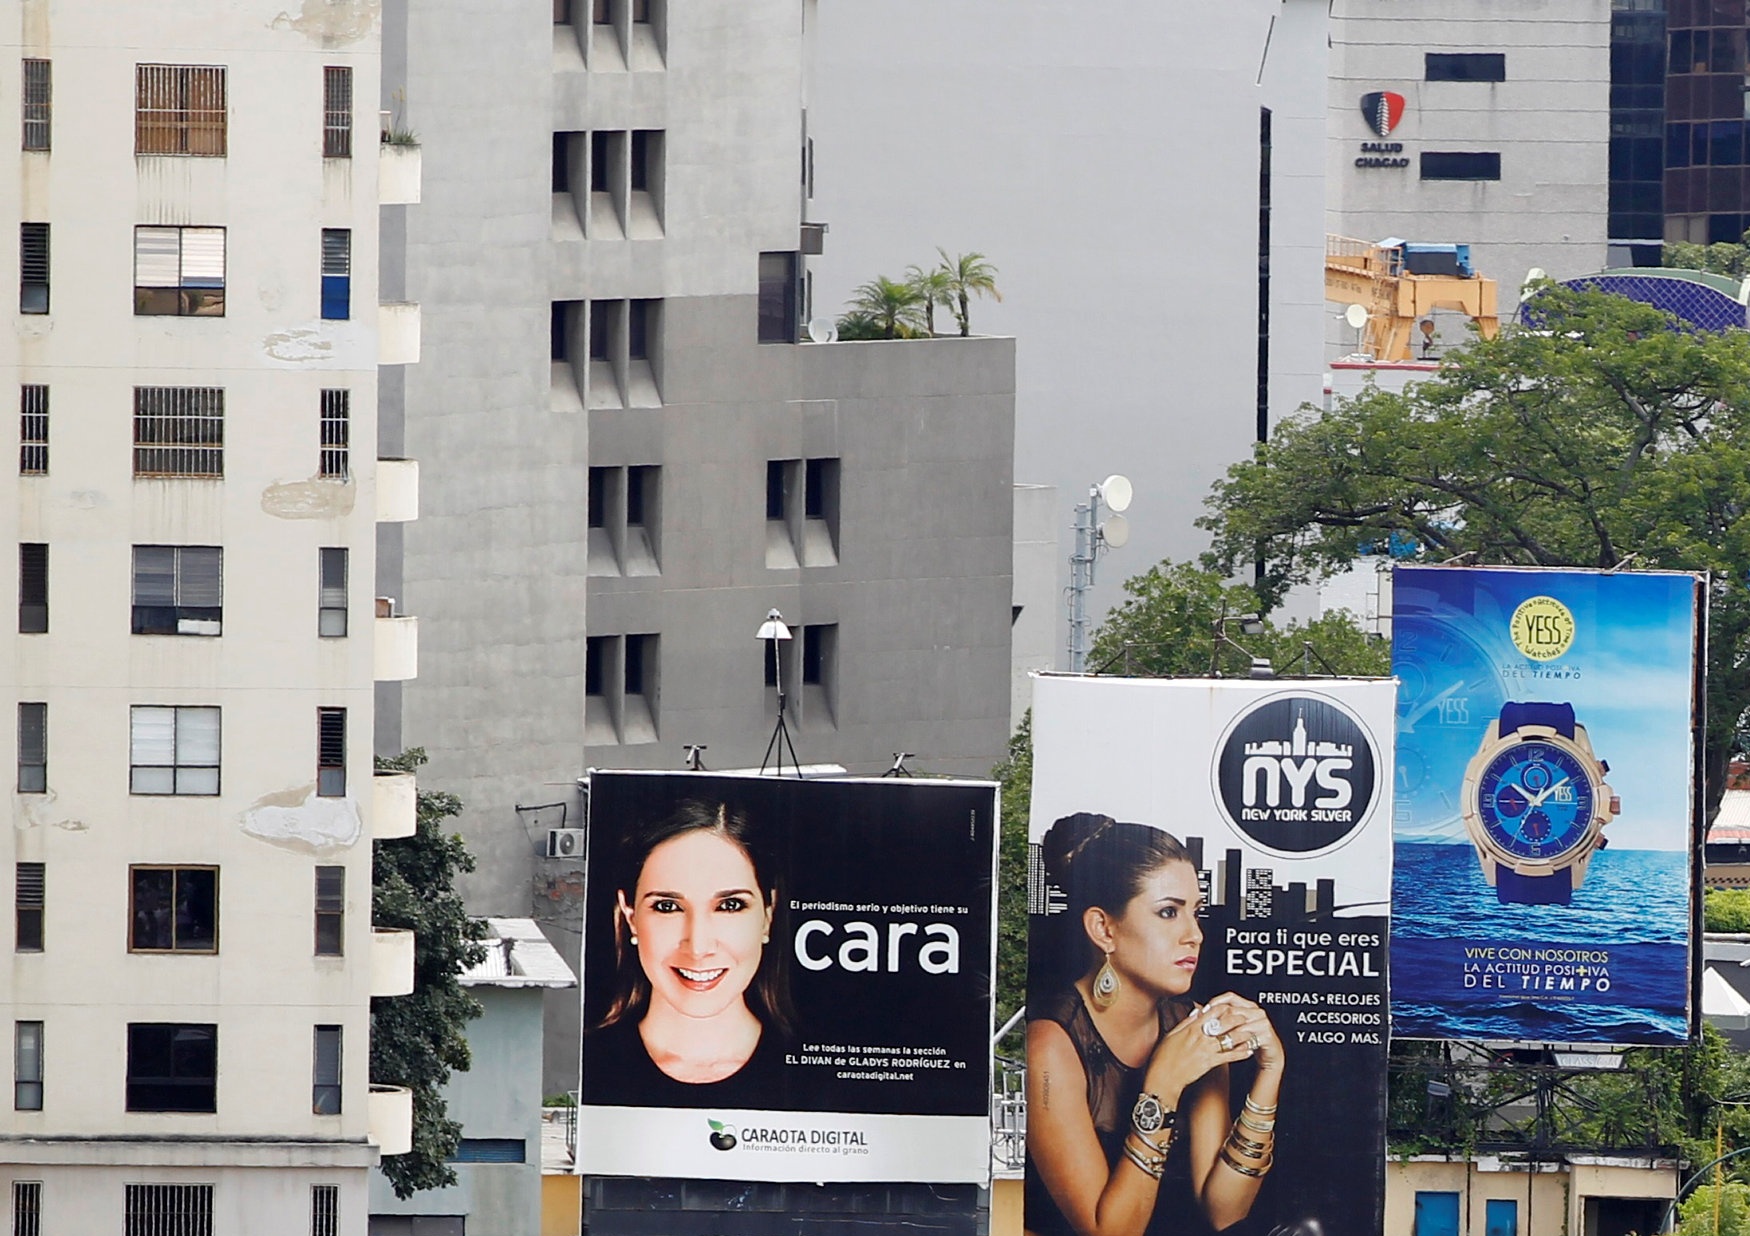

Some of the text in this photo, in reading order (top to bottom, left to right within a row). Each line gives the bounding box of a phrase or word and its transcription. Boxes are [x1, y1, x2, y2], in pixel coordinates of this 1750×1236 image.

[1360, 143, 1403, 153] SALUD
[1354, 157, 1410, 168] CHACAO
[1525, 614, 1561, 645] YESS
[1533, 670, 1581, 680] TIEMPO
[1242, 808, 1352, 822] NEW YORK SILVER
[790, 900, 968, 915] El periodismo serio y objetivo tiene su
[1226, 928, 1380, 949] Para ti que eres
[794, 919, 960, 975] cara
[1464, 947, 1609, 963] VIVE CON NOSOTROS
[1226, 949, 1380, 977] ESPECIAL
[1464, 963, 1480, 973] LA
[1485, 963, 1540, 975] ACTITUD
[1464, 974, 1610, 992] DEL TIEMPO
[1296, 1012, 1381, 1025] ACCESORIOS
[1297, 1031, 1346, 1044] Y ALGO
[803, 1043, 819, 1052] Lee
[821, 1044, 846, 1053] todas
[847, 1045, 860, 1054] las
[862, 1046, 900, 1055] semanas
[902, 1046, 911, 1055] la
[785, 1054, 966, 1069] EL DIVAN de GLADYS RODRÍGUEZ en
[741, 1128, 868, 1146] CARAOTA DIGITAL
[743, 1143, 869, 1155] Información directo al grano
